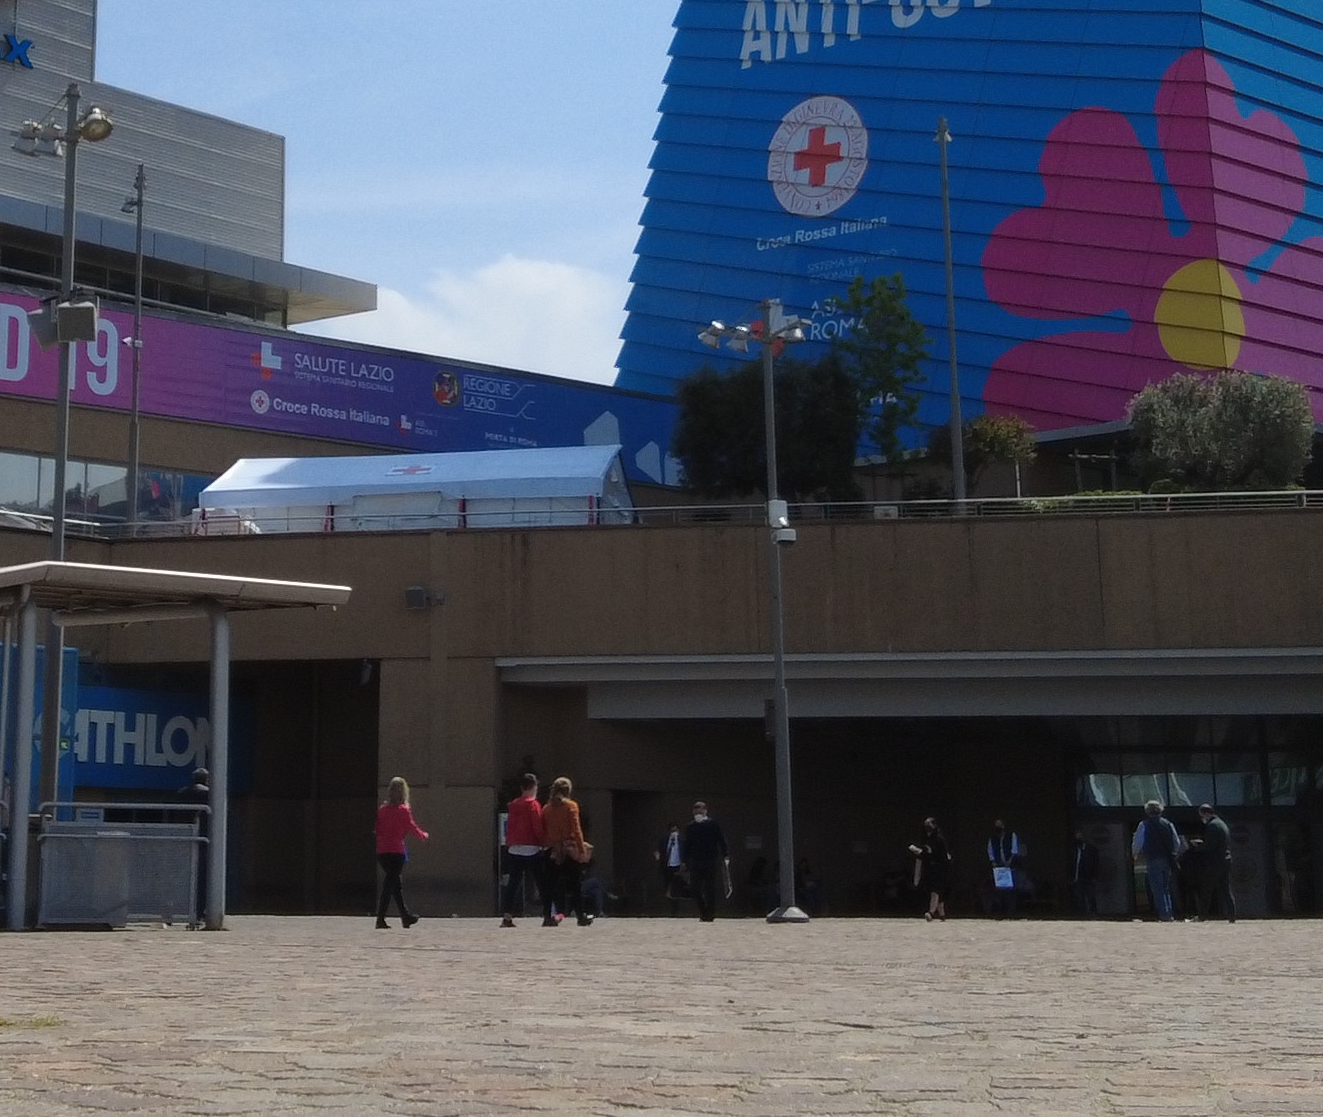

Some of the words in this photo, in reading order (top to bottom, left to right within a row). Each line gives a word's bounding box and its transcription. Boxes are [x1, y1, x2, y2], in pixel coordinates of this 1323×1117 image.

[756, 235, 791, 251] Croce
[795, 226, 837, 244] Rossa
[840, 215, 887, 234] Italiana
[294, 353, 346, 376] SALUTE
[351, 362, 394, 382] LAZIO
[463, 377, 511, 396] REGIONE
[273, 397, 308, 415] Croce
[311, 403, 347, 420] Rossa
[350, 408, 390, 426] Italiana
[463, 394, 497, 411] LAZIO
